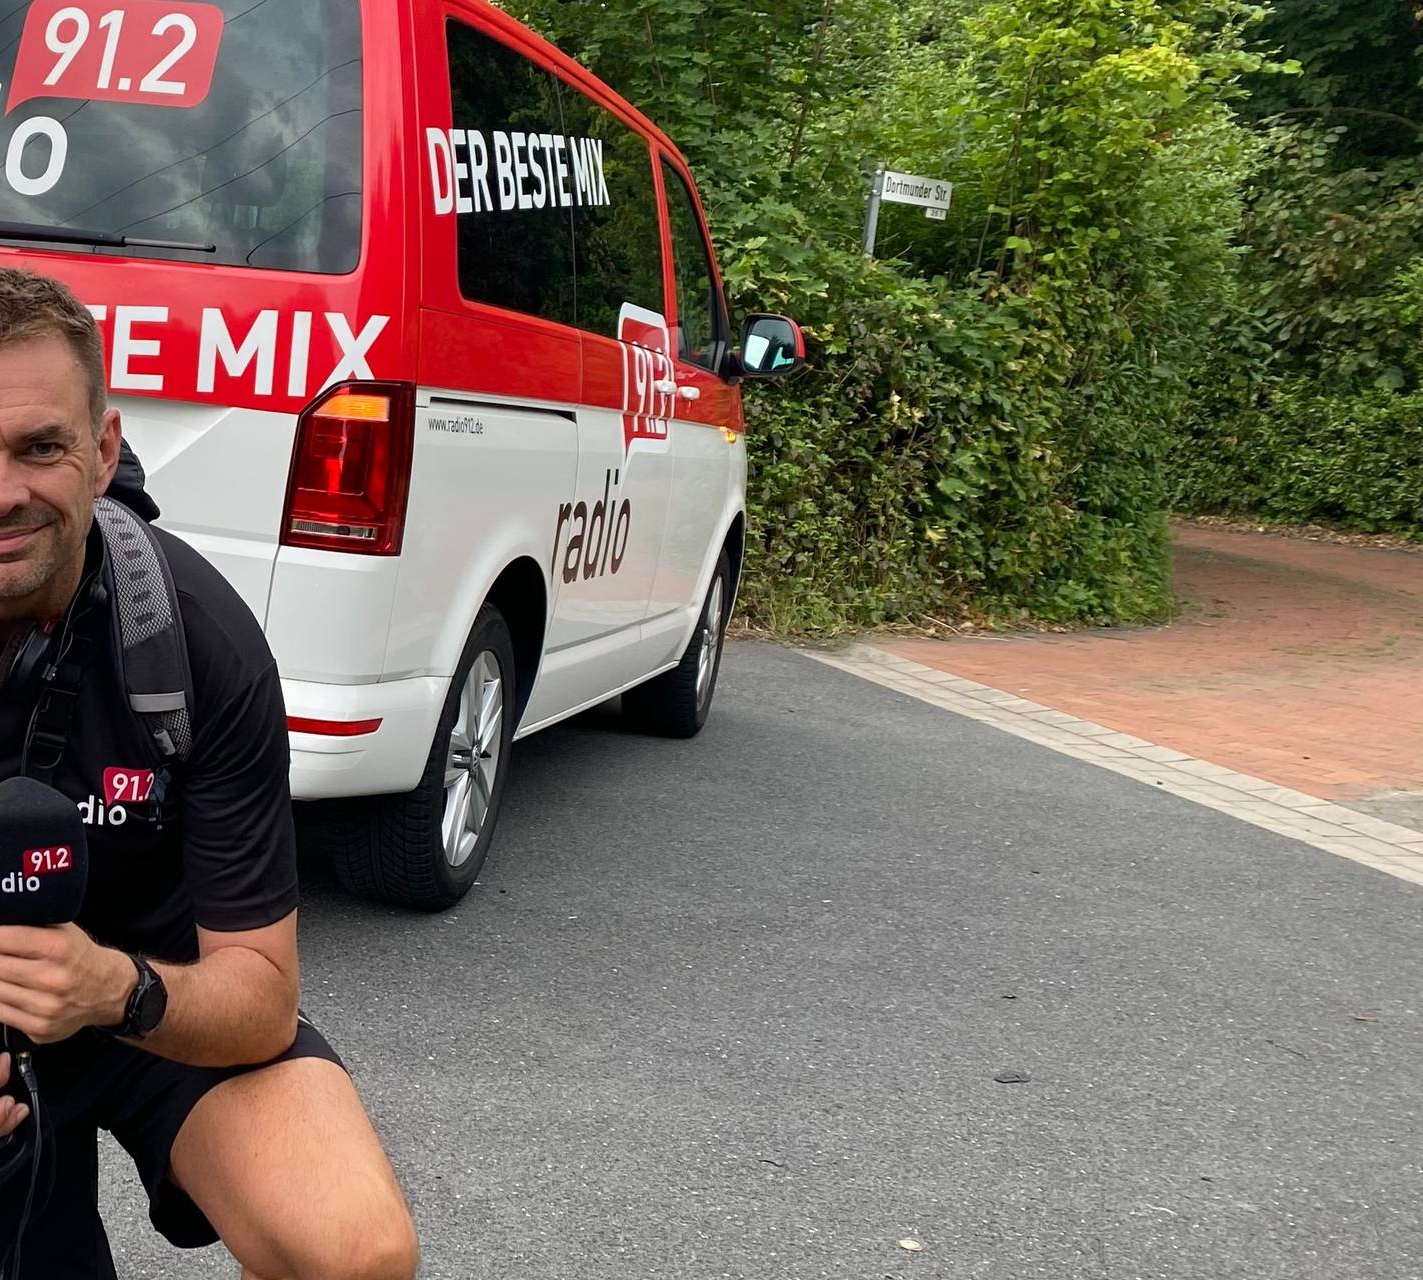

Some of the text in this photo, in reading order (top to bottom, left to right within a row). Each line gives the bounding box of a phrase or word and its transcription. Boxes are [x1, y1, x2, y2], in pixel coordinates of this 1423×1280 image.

[43, 7, 197, 95] 91.2
[425, 127, 611, 215] DER BESTE MIX
[886, 176, 948, 202] Dortmunder Str.
[196, 307, 391, 398] MIX
[427, 416, 483, 435] www.radio912.de
[551, 468, 631, 586] radio
[77, 795, 127, 826] dio
[31, 847, 70, 872] 91.2
